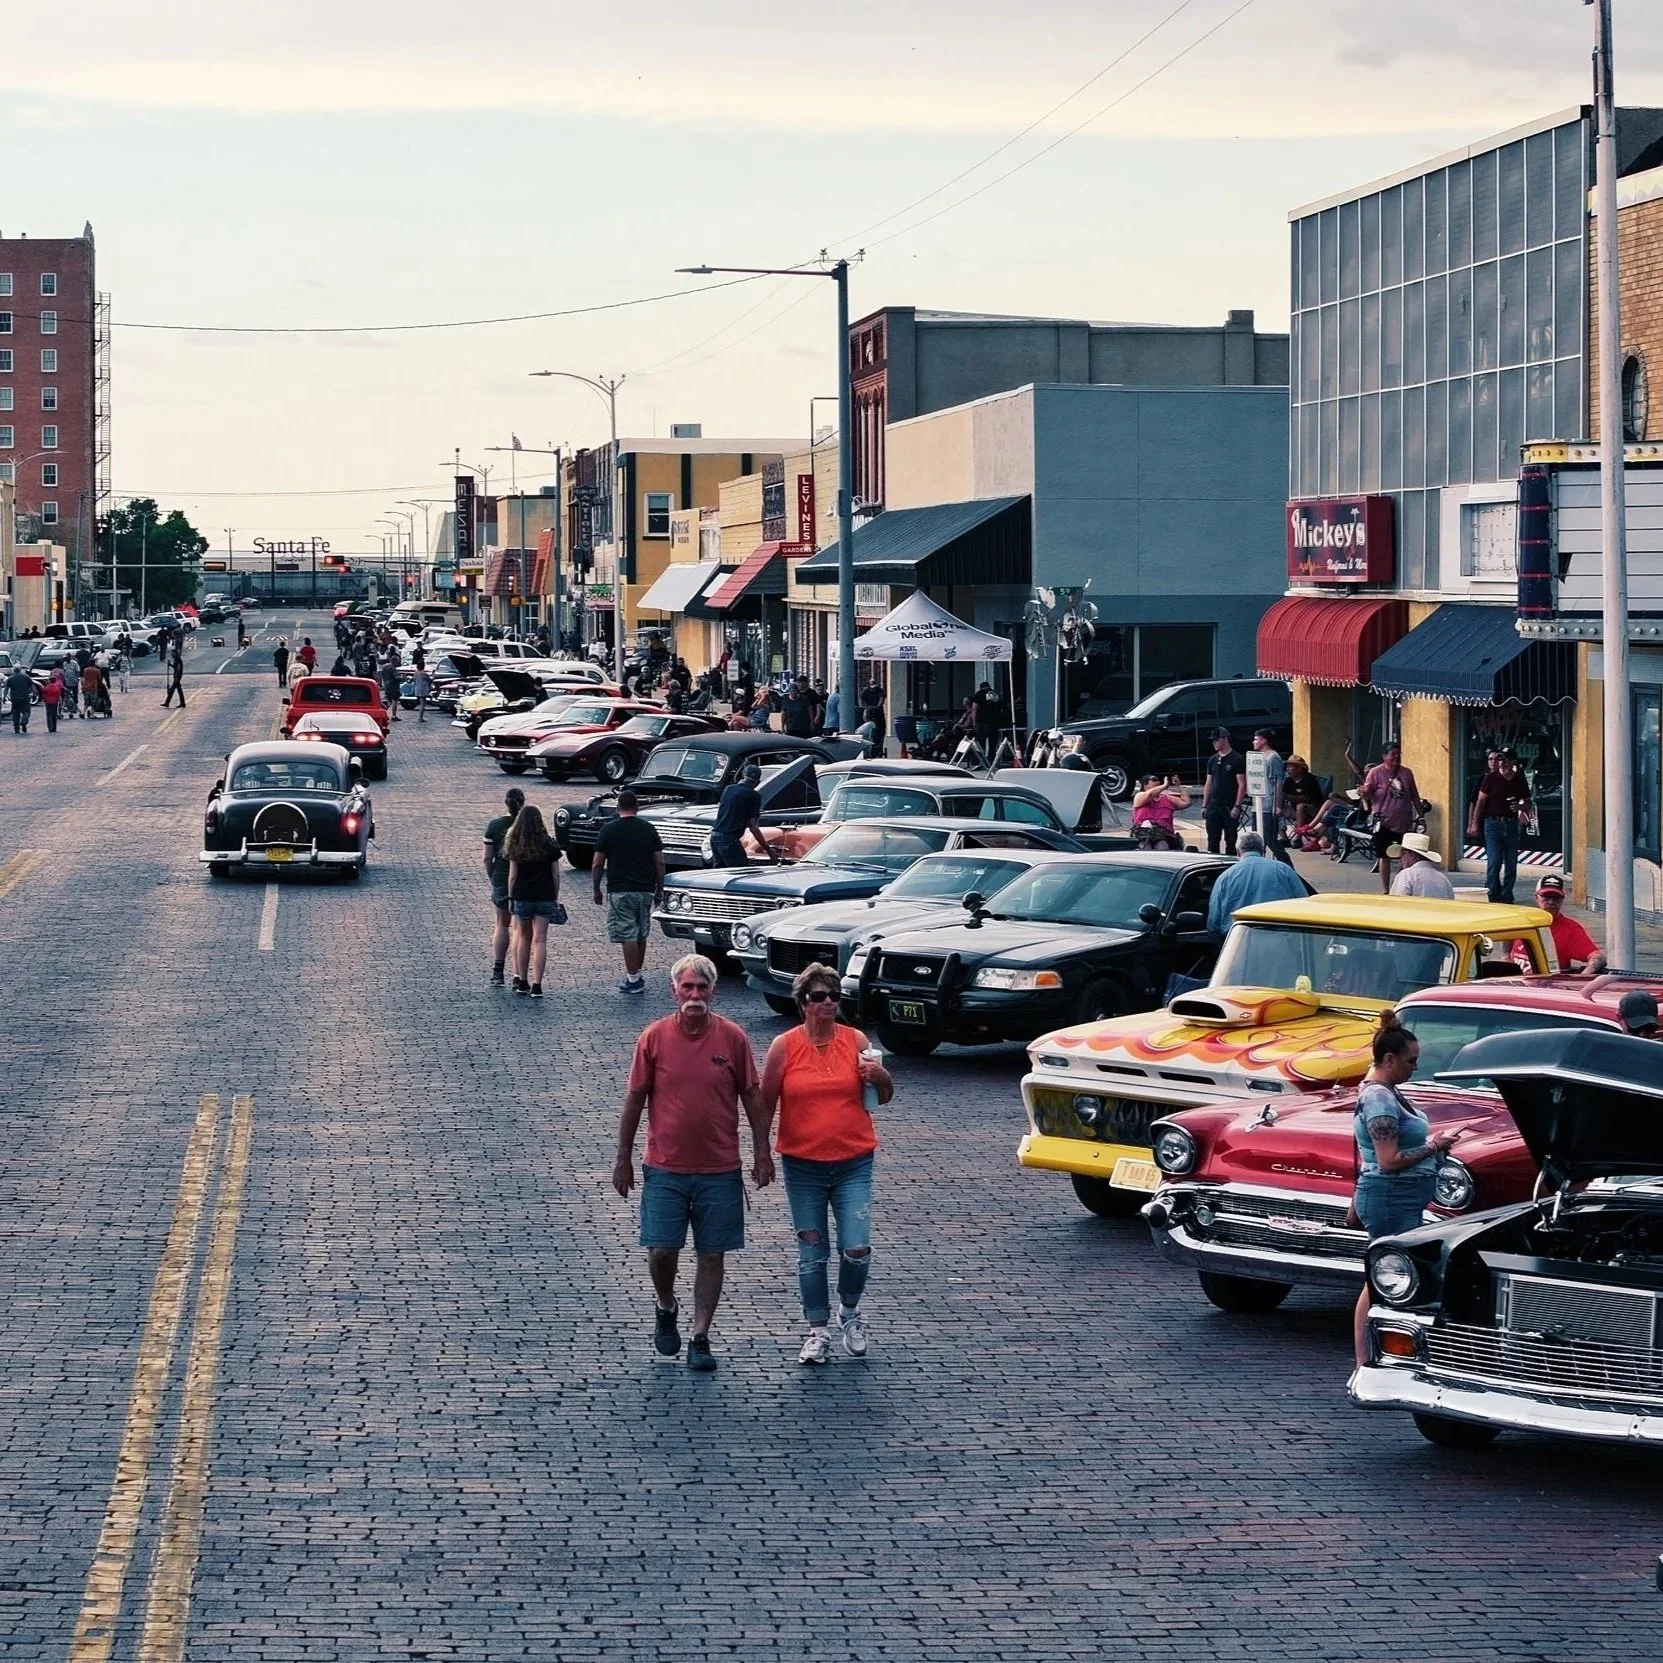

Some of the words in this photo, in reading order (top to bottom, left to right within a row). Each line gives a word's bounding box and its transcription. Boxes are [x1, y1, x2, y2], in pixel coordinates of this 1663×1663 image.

[801, 476, 812, 541] LEVINES
[253, 537, 306, 554] Santa
[311, 536, 331, 554] Fe
[901, 631, 946, 640] Media
